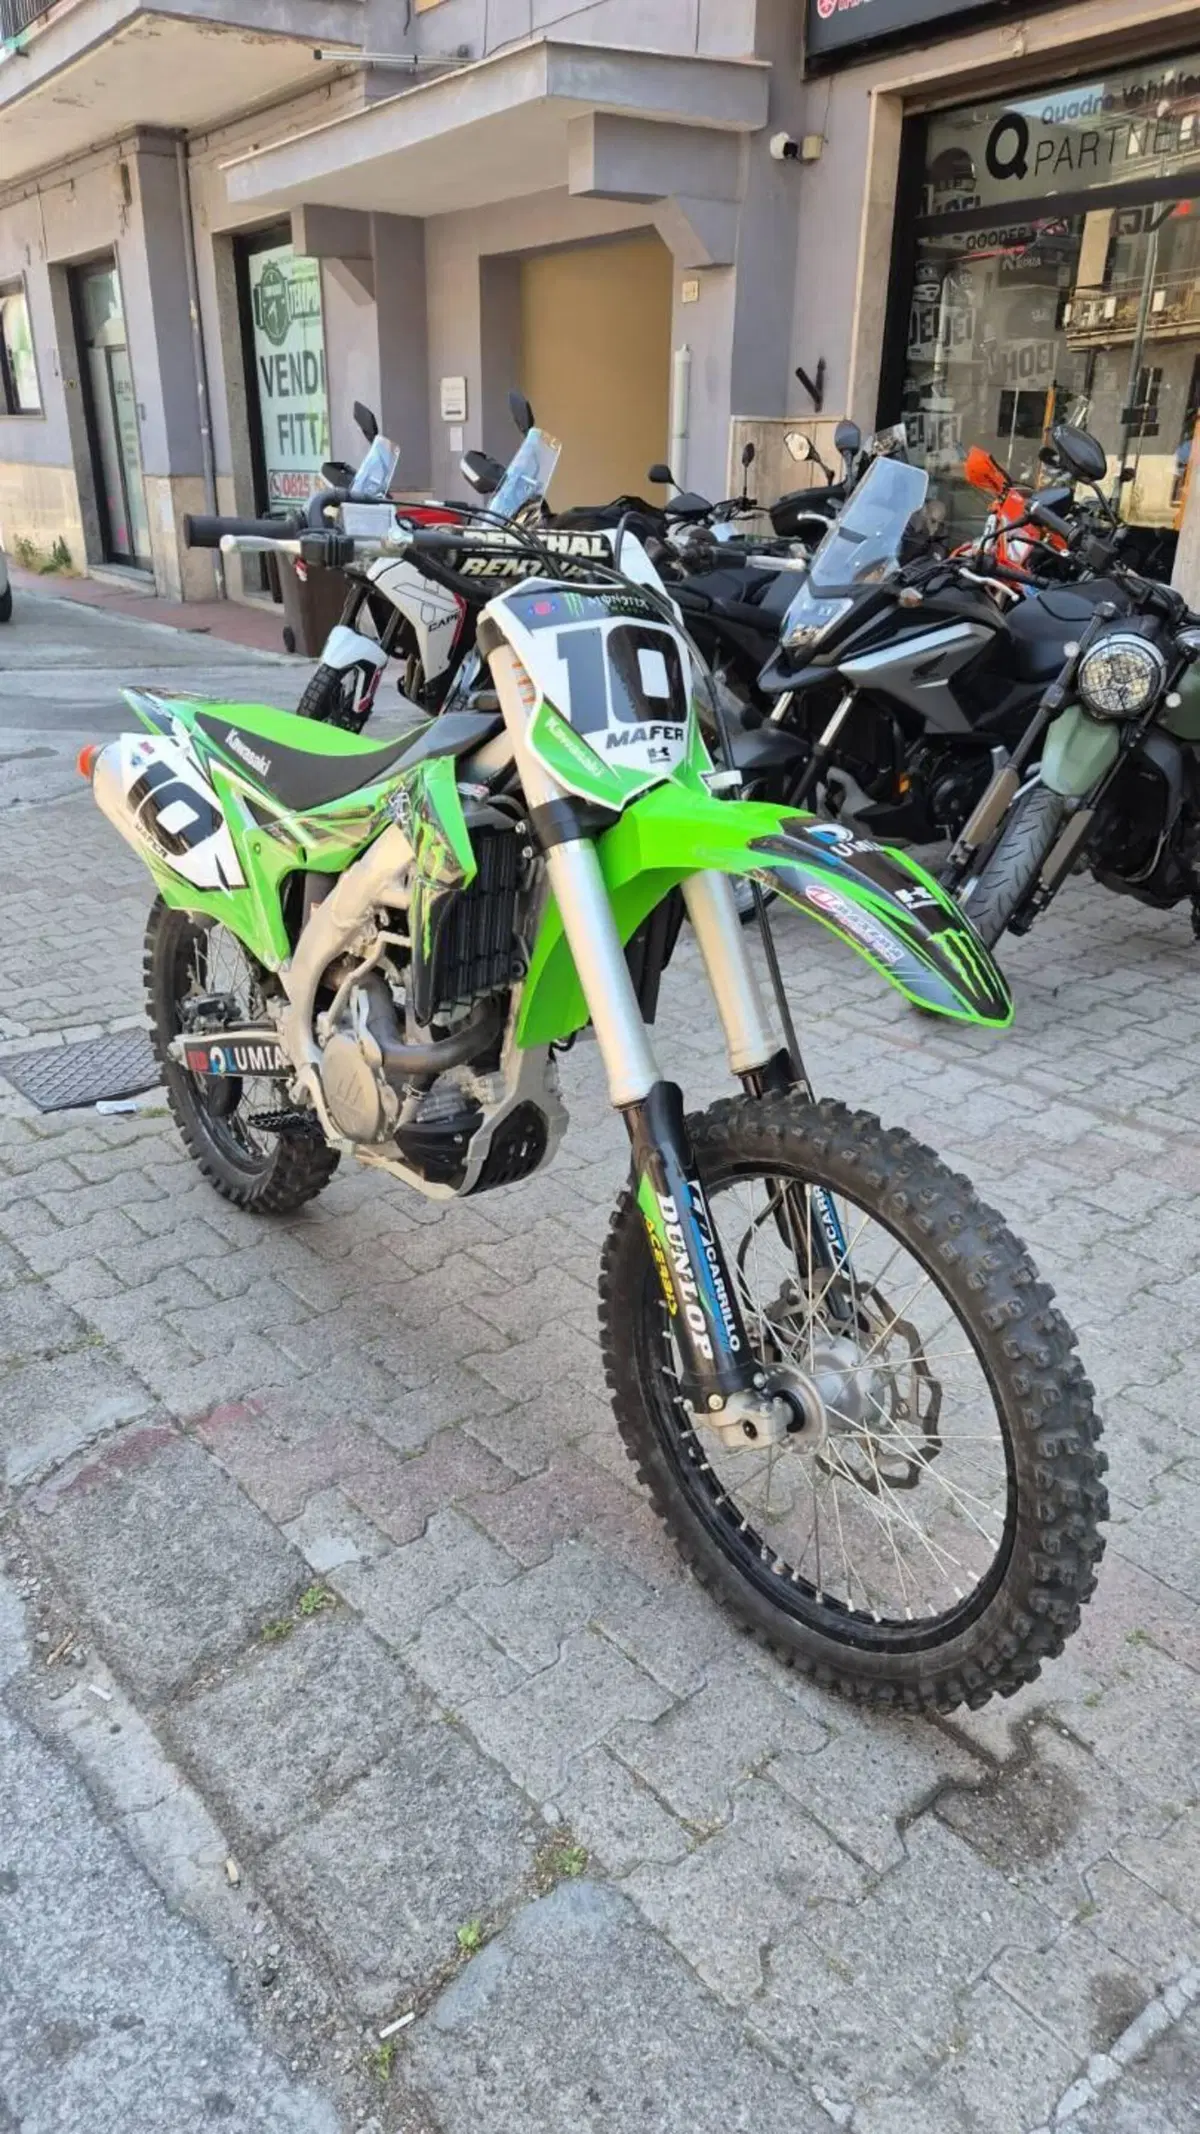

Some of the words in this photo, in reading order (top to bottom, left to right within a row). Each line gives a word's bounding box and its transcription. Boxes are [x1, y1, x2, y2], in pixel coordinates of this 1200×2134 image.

[1041, 93, 1115, 125] Quadro
[459, 557, 590, 578] RENTA
[557, 623, 688, 735] 10
[224, 728, 272, 777] Kawasaki
[606, 725, 684, 750] MAFER
[656, 1194, 714, 1360] DUNLOP
[706, 1247, 742, 1352] CARRILLO
